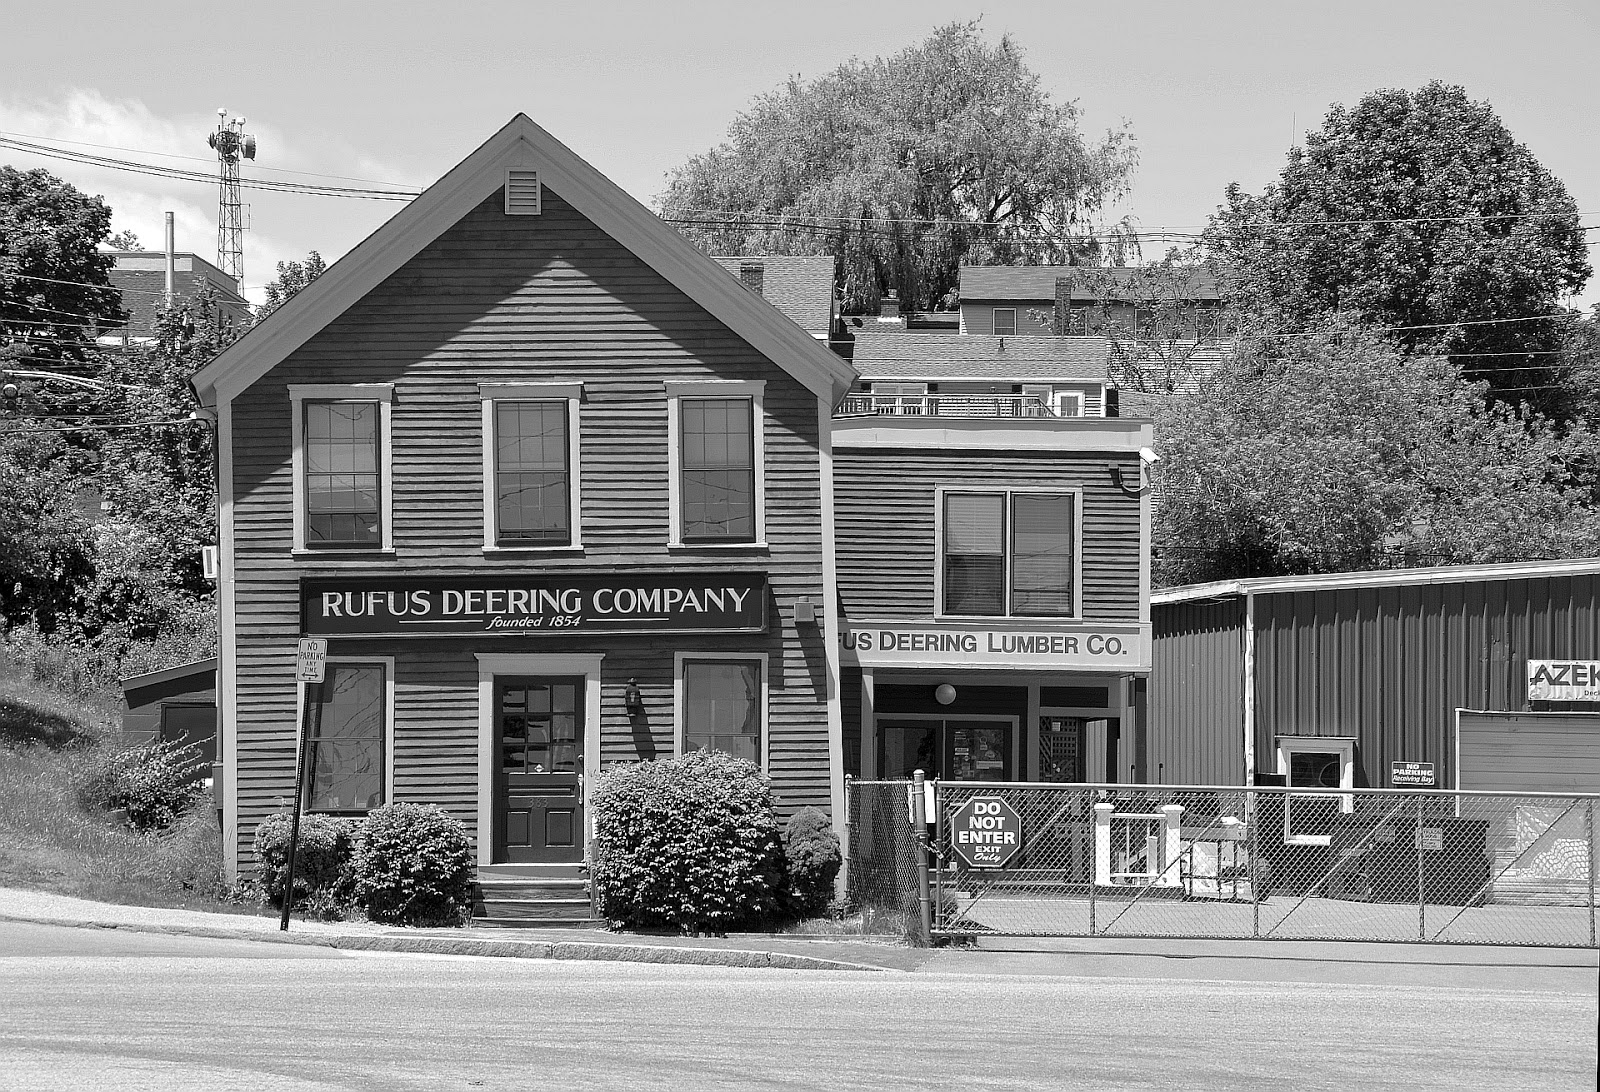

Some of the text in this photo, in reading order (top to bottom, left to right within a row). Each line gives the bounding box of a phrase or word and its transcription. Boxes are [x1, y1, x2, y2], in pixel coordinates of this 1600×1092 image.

[322, 587, 750, 617] RUFUS DEERING COMPANY
[485, 615, 582, 630] founded 1854
[307, 641, 318, 651] NO
[300, 651, 324, 661] PARKING
[1393, 768, 1433, 777] PARKING
[974, 802, 1001, 815] DO
[969, 816, 1006, 830] NOT
[958, 830, 1016, 844] ENTER
[975, 845, 1002, 853] EXIT
[973, 852, 1002, 863] Only
